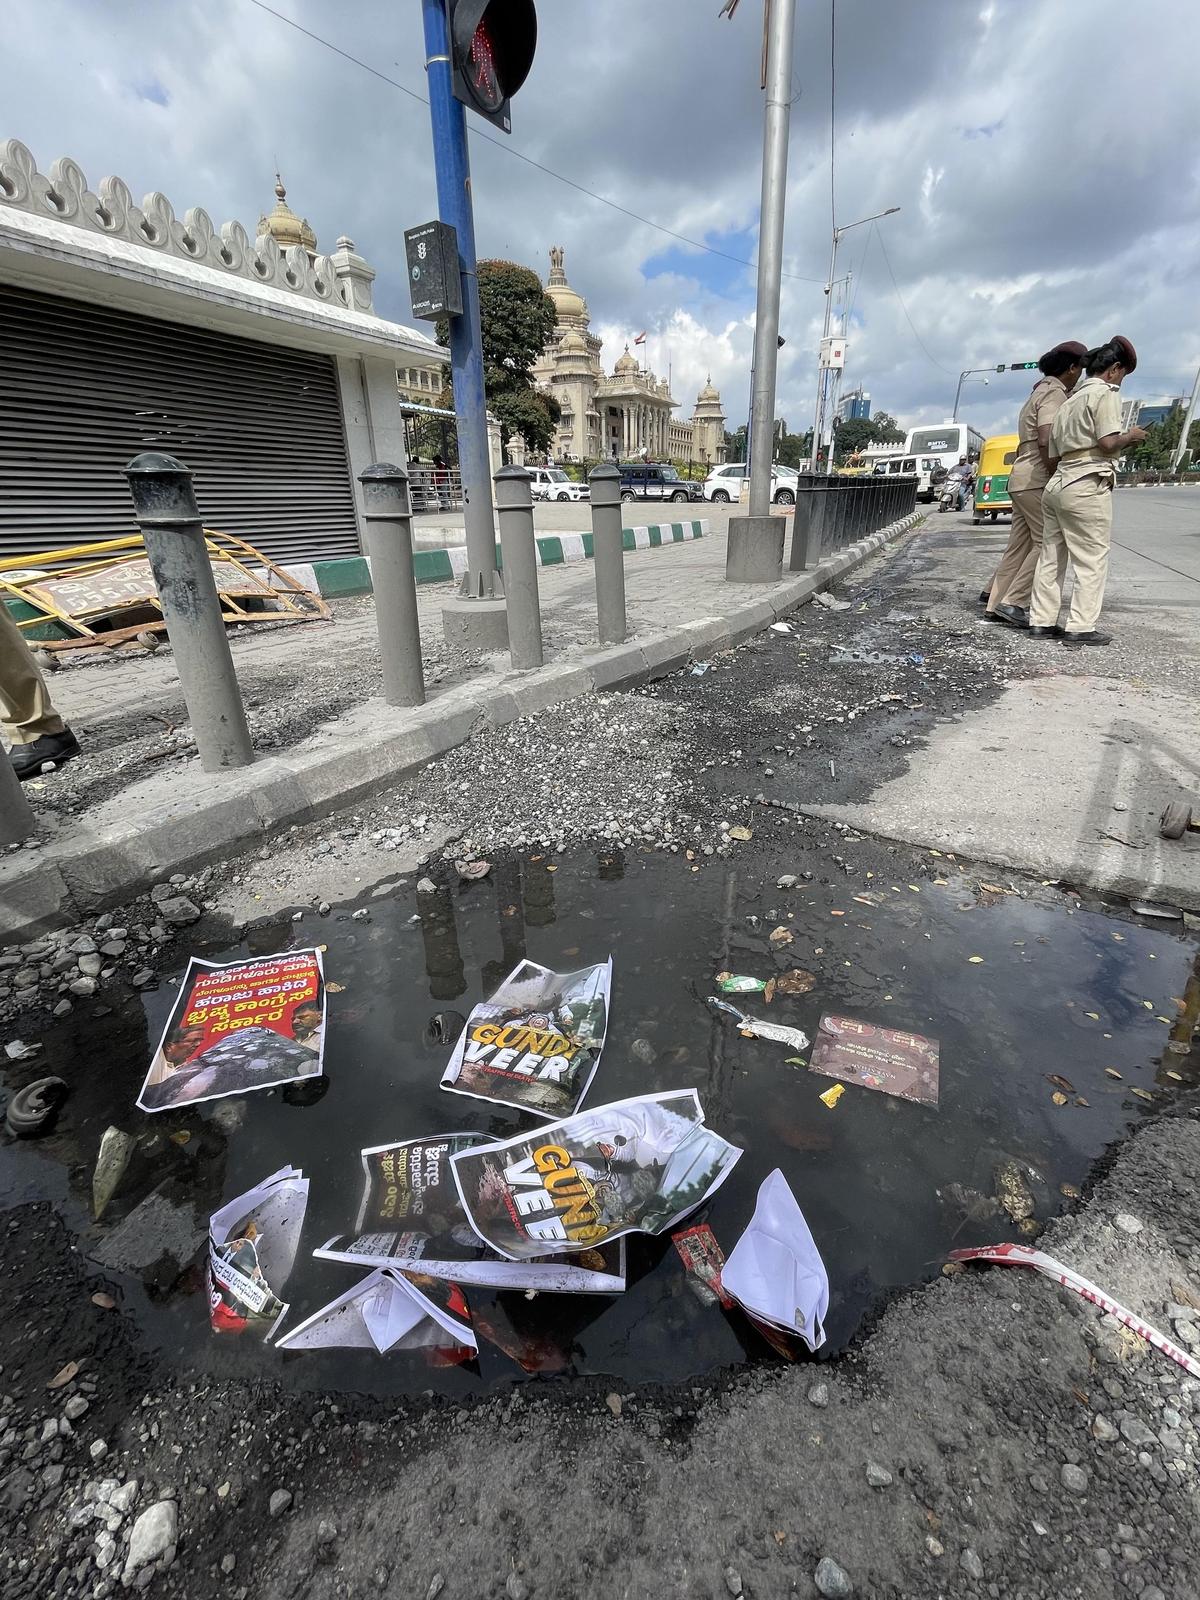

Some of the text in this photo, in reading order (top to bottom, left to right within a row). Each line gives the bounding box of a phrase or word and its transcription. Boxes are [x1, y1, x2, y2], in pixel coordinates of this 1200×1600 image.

[187, 987, 314, 1026] ಭ್ರಷ್ಟ ಕಾಂಗ್ರೆಸ್
[195, 979, 308, 1008] ಹರಾಜು ಹಾಕಿದ
[210, 1008, 285, 1033] ಸರ್ಕಾರ
[465, 1042, 569, 1081] VEER
